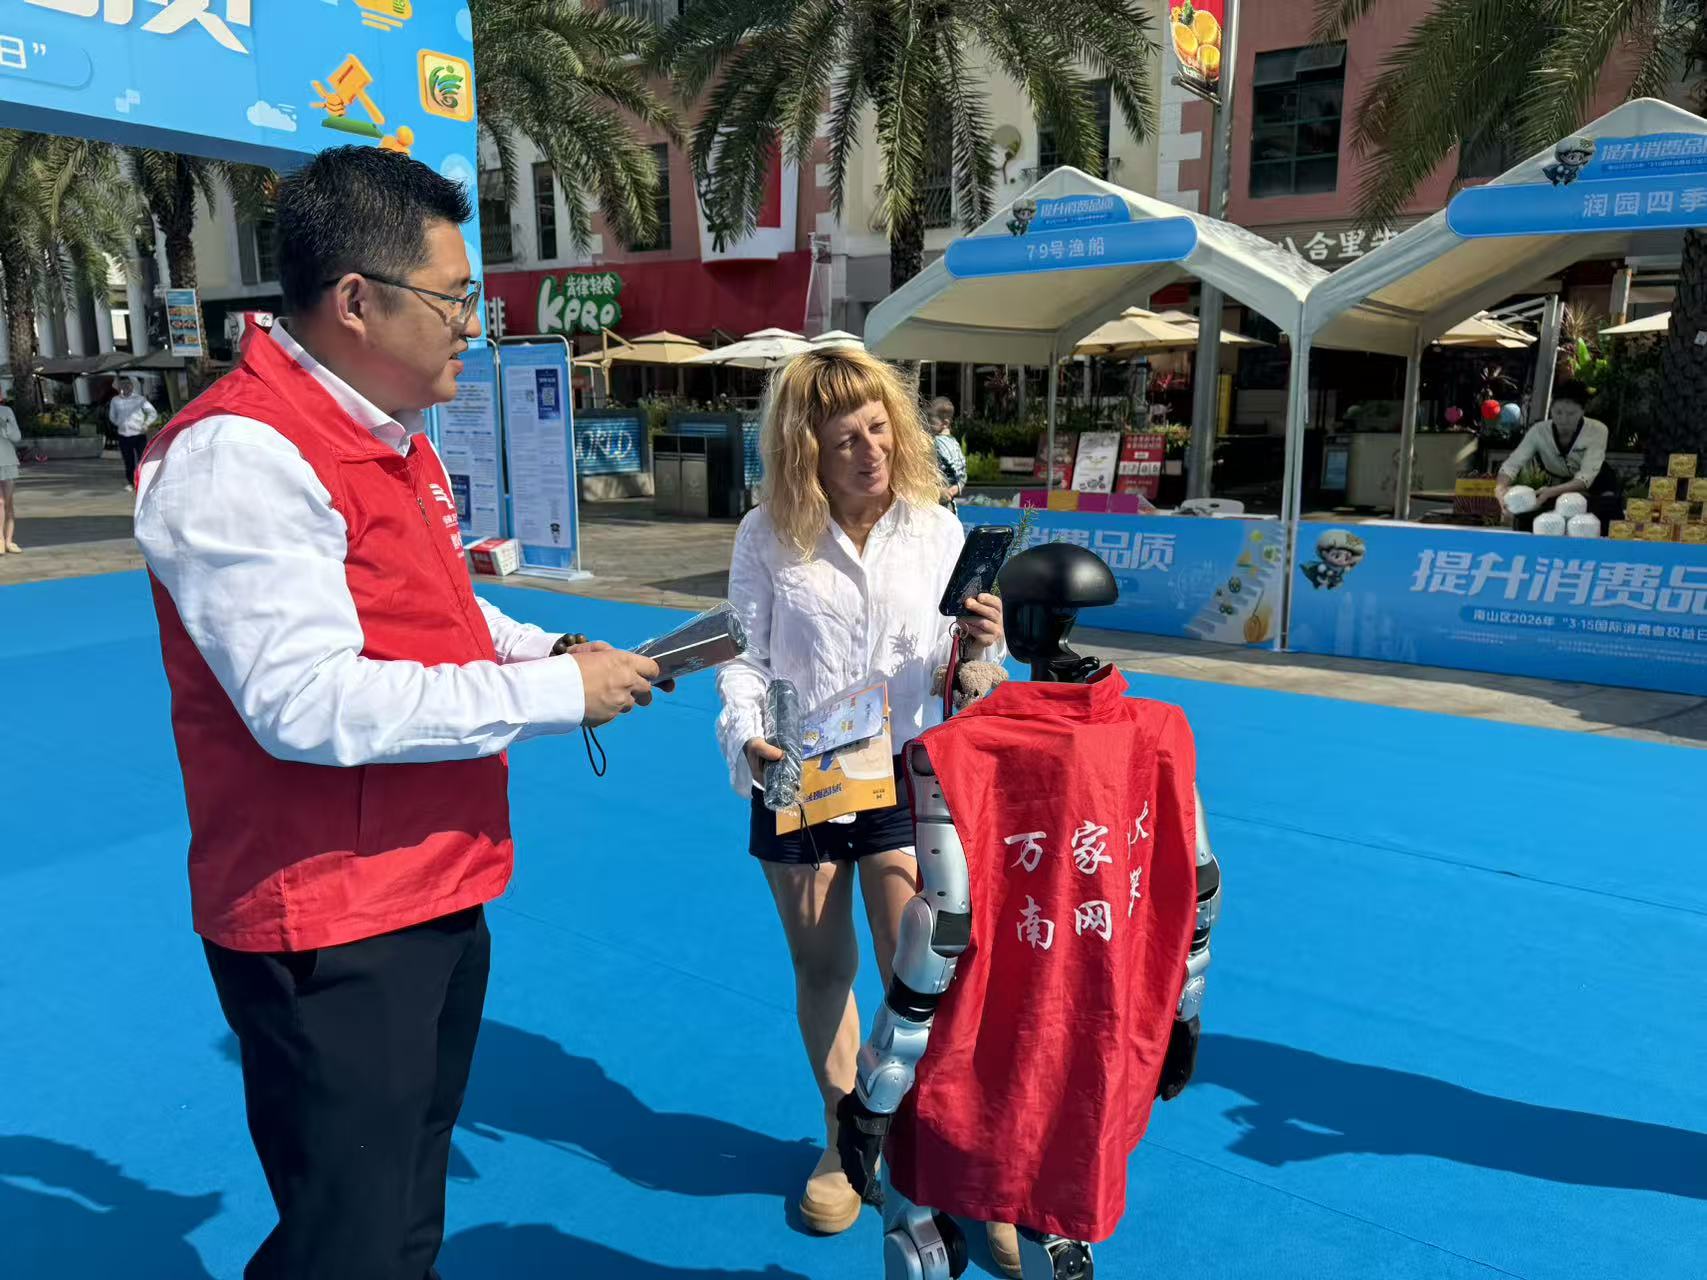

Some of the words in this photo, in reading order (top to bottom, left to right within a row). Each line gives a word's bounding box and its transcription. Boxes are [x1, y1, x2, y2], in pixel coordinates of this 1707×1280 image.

[1601, 136, 1707, 161] 提升消费品
[1583, 187, 1707, 217] 润园四季
